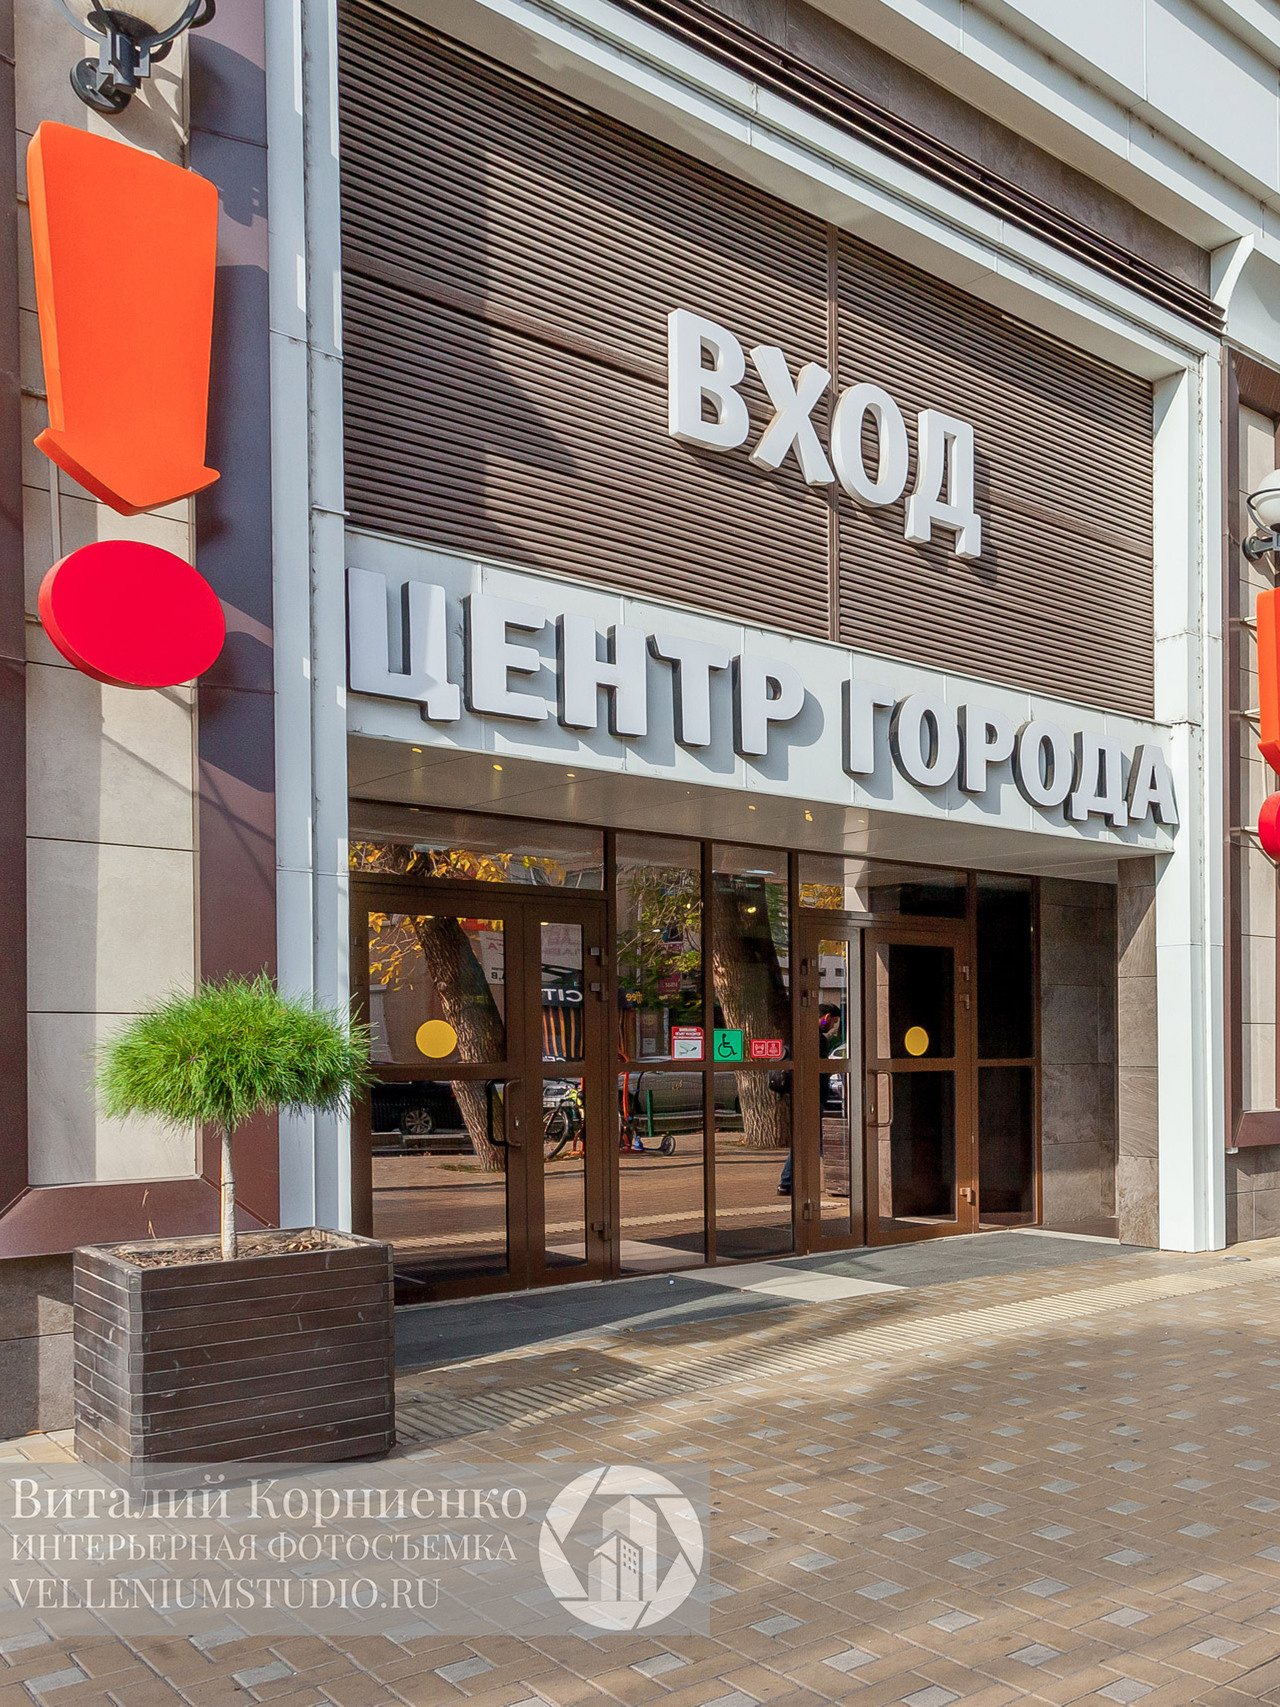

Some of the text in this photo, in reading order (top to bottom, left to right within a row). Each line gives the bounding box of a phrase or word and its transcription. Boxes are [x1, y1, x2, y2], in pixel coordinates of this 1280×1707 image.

[667, 307, 983, 560] ВХОД
[346, 566, 1180, 829] ЦЕНТР ГОРОДА
